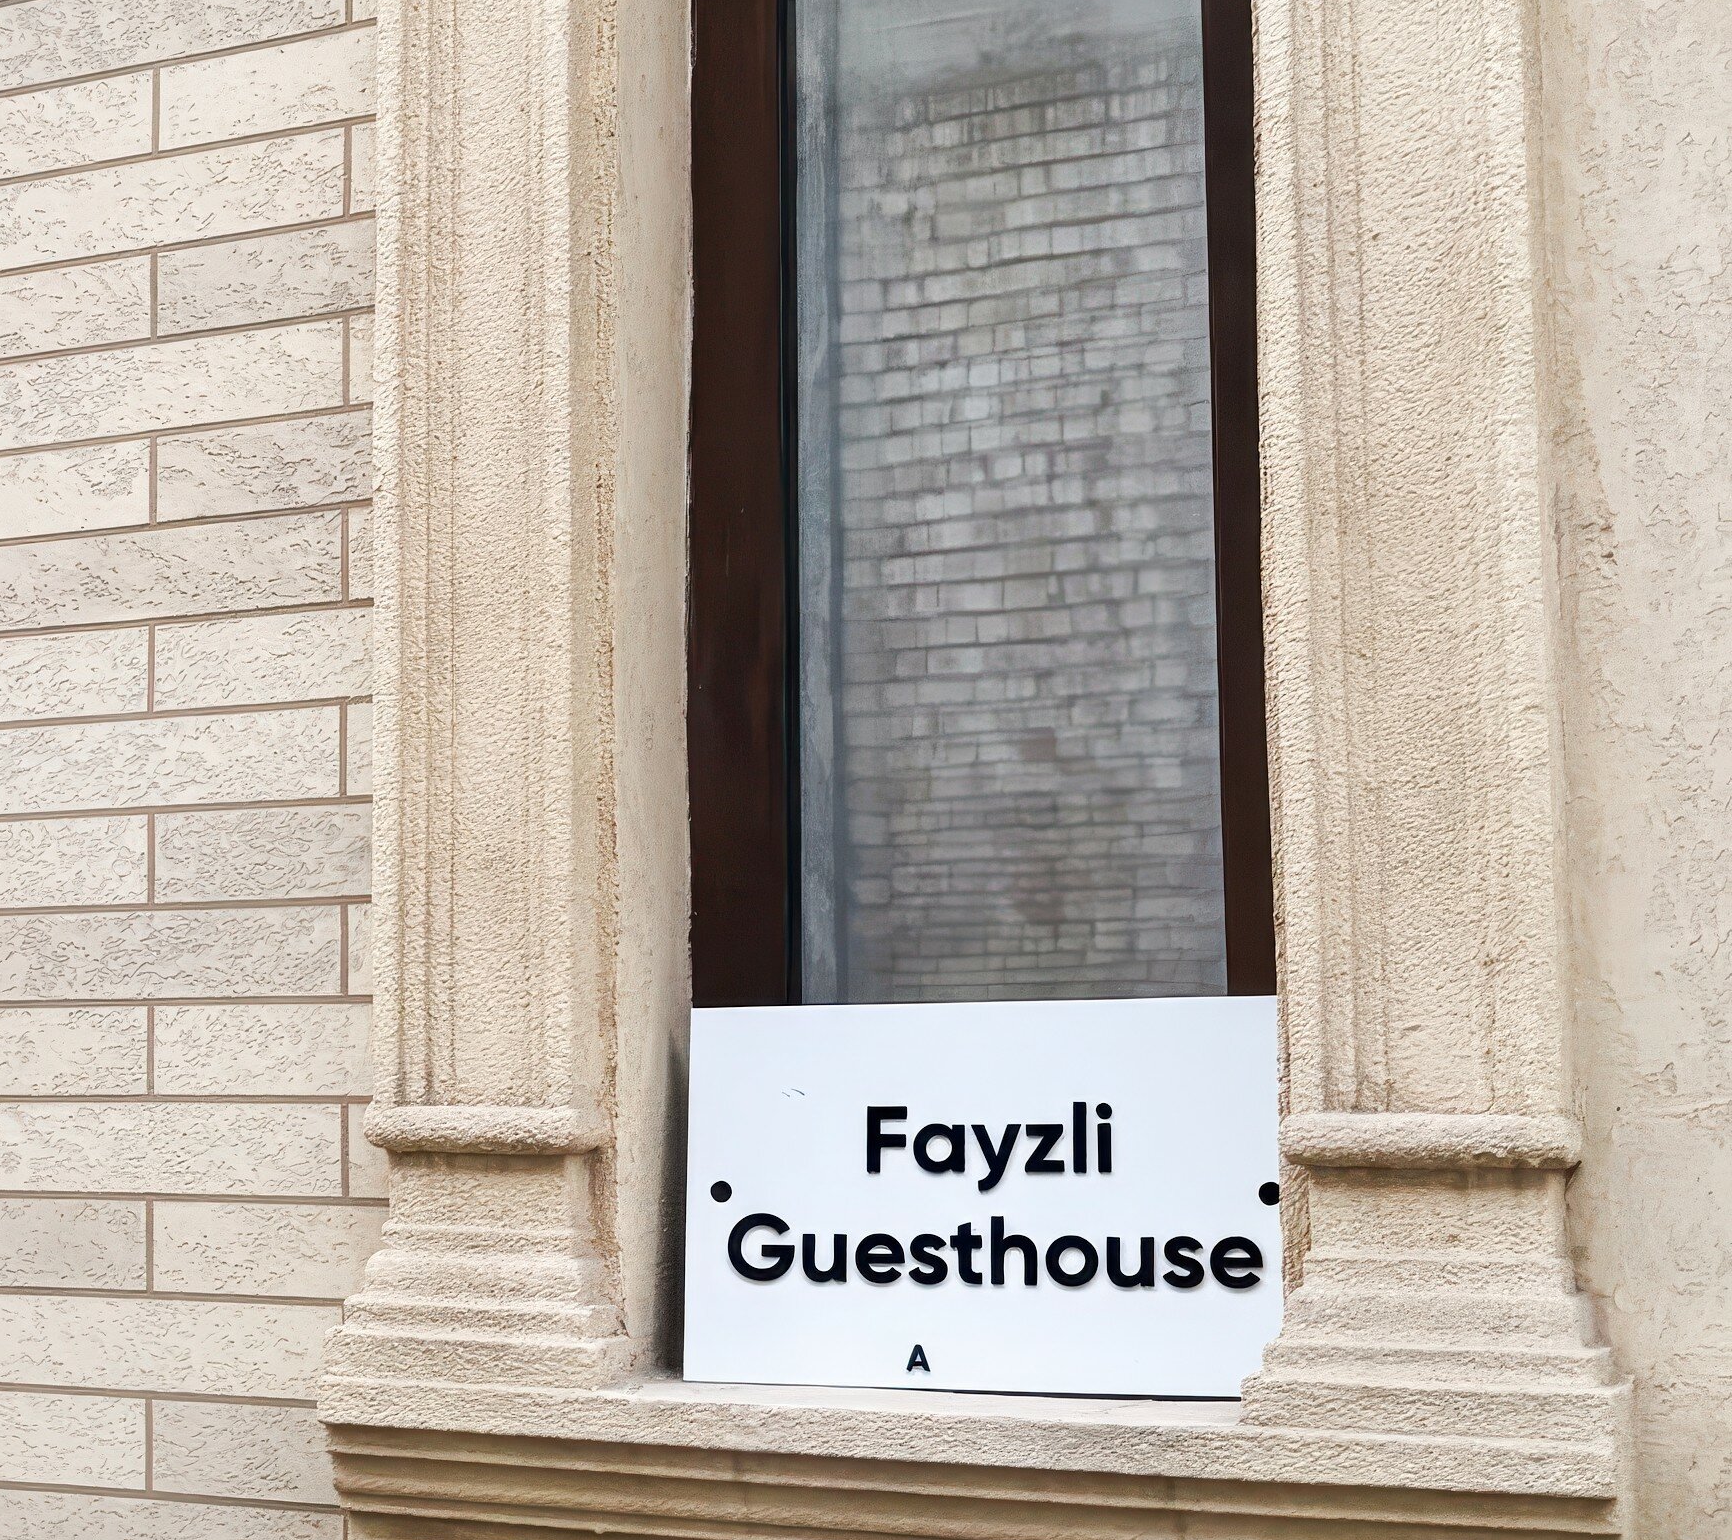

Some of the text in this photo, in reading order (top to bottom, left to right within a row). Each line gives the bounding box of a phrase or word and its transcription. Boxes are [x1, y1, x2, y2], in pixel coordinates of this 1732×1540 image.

[867, 1101, 1113, 1192] Fayzli
[727, 1213, 1264, 1289] Guesthouse
[906, 1344, 931, 1373] A
